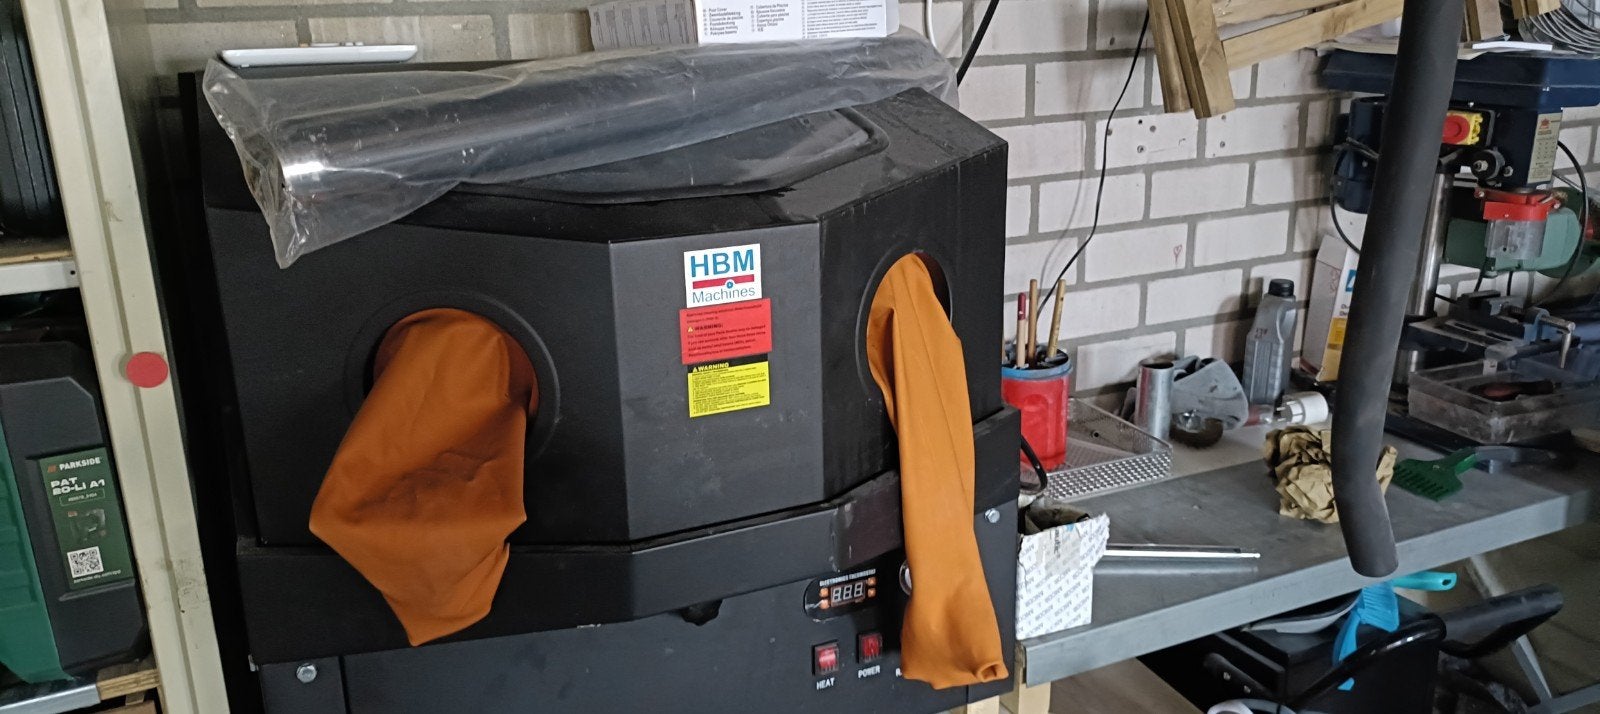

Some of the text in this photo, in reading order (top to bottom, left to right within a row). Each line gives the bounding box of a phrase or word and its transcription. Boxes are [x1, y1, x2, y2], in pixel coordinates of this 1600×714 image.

[690, 249, 754, 278] HBM
[692, 286, 756, 304] Machines
[698, 362, 730, 372] WARNING
[59, 457, 101, 471] PARKSIDE
[50, 476, 78, 488] PAT
[89, 478, 105, 489] A1
[857, 665, 881, 678] POWER
[816, 677, 835, 690] HEAT
